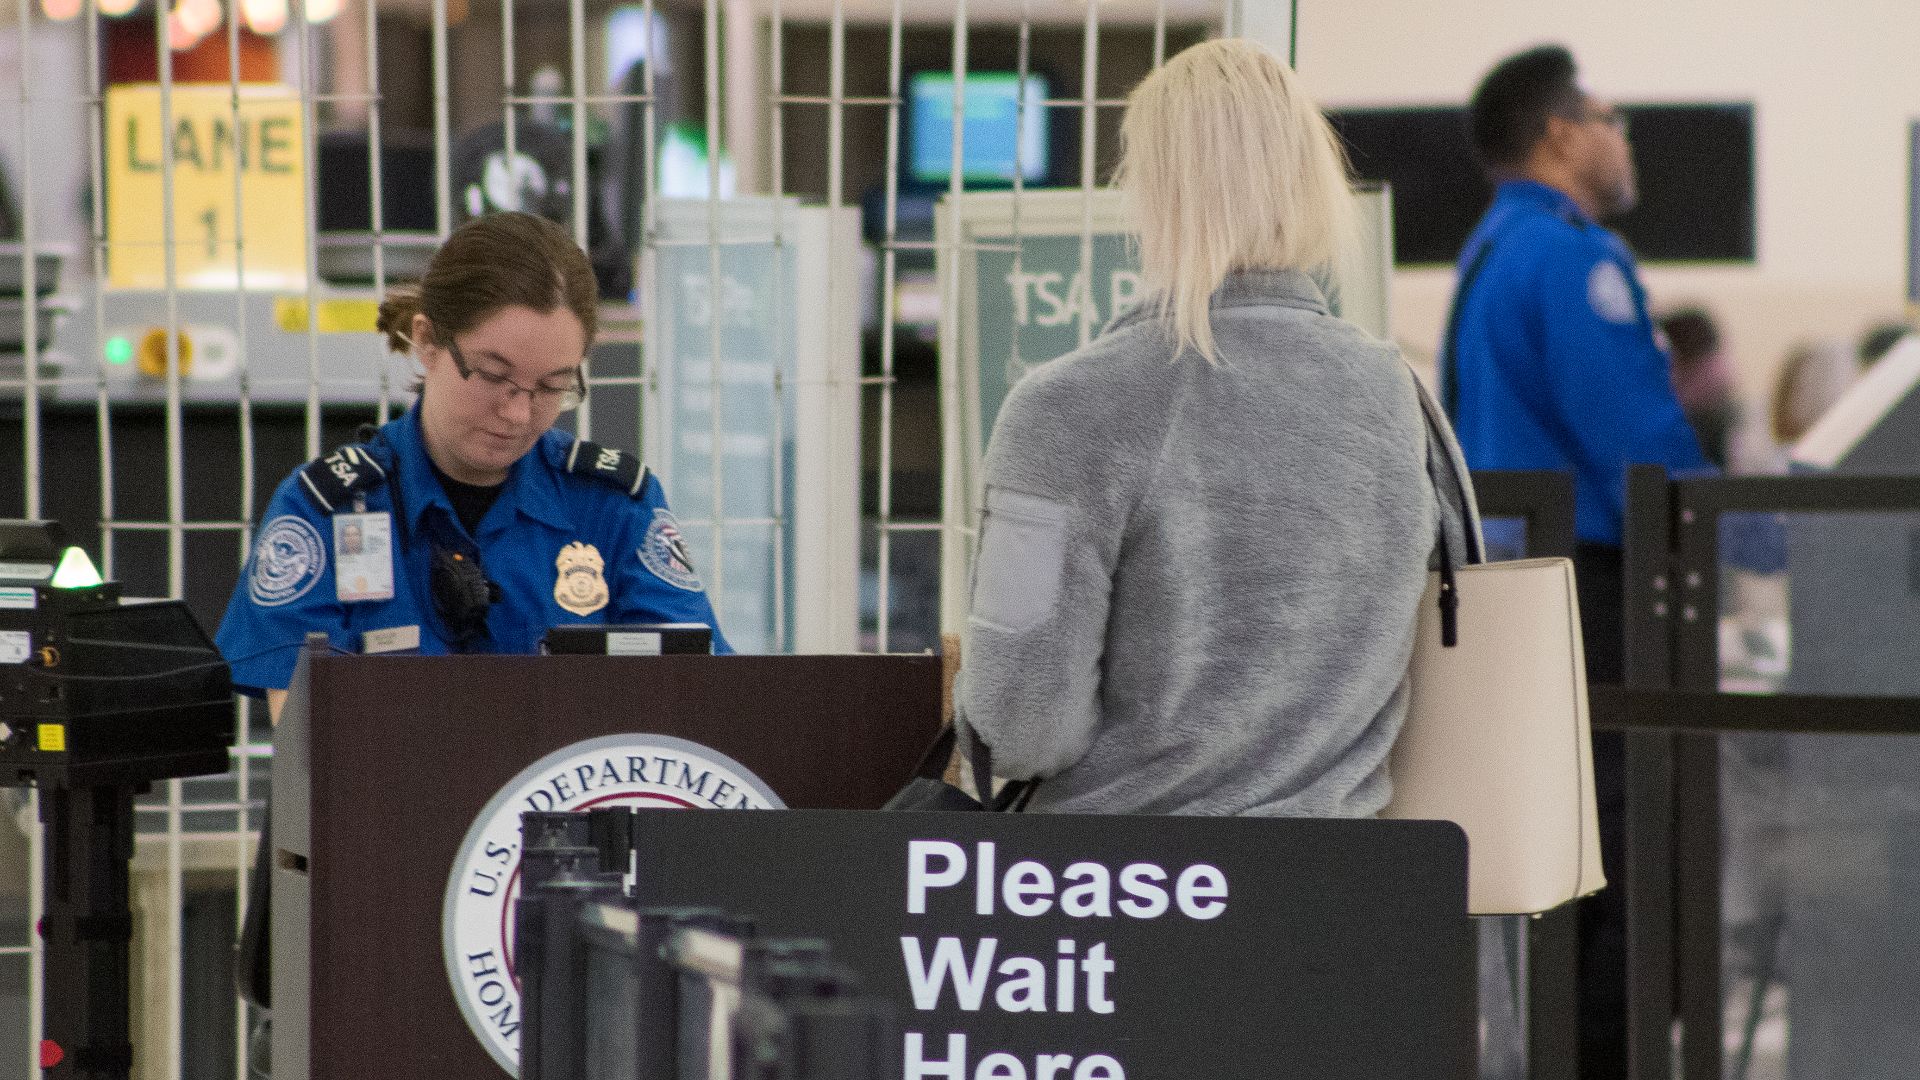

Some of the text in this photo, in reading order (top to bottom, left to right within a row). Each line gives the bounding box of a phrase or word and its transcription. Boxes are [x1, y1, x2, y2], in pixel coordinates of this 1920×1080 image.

[126, 115, 294, 174] LANE
[199, 207, 219, 258] 1
[1006, 273, 1099, 325] TSA
[324, 450, 359, 487] TSA
[595, 447, 621, 471] TSA
[470, 841, 517, 897] U.S.
[907, 840, 1228, 920] Please
[467, 948, 520, 1052] HOM
[900, 936, 1115, 1014] Wait
